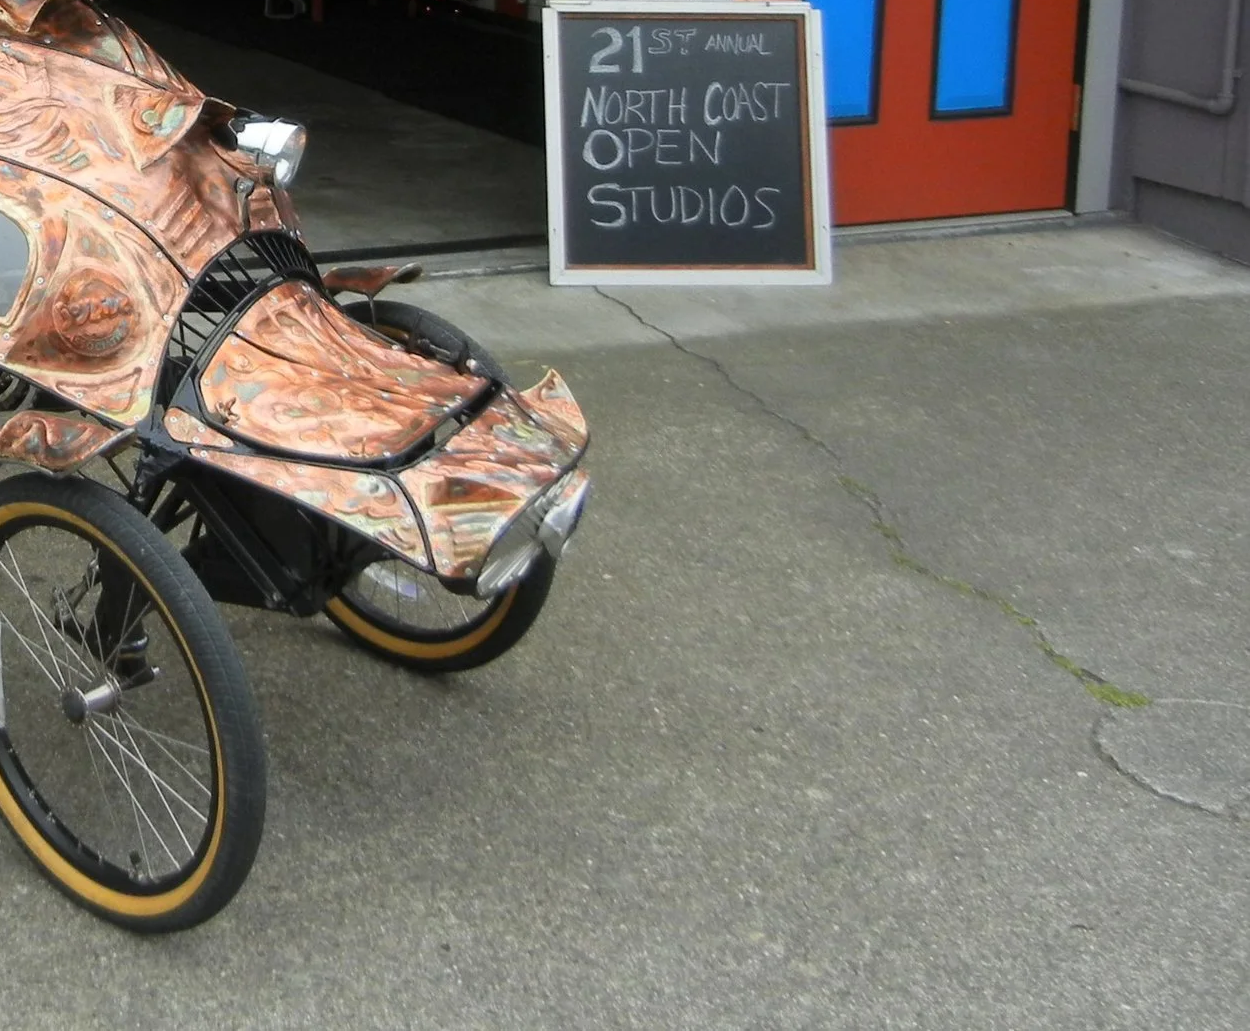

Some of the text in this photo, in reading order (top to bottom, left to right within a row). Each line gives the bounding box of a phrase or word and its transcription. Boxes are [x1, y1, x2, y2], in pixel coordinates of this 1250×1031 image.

[704, 33, 774, 56] ANNUAL
[580, 81, 791, 128] NORTH COAST
[582, 128, 723, 170] OPEN
[586, 182, 781, 229] STUDIOS
